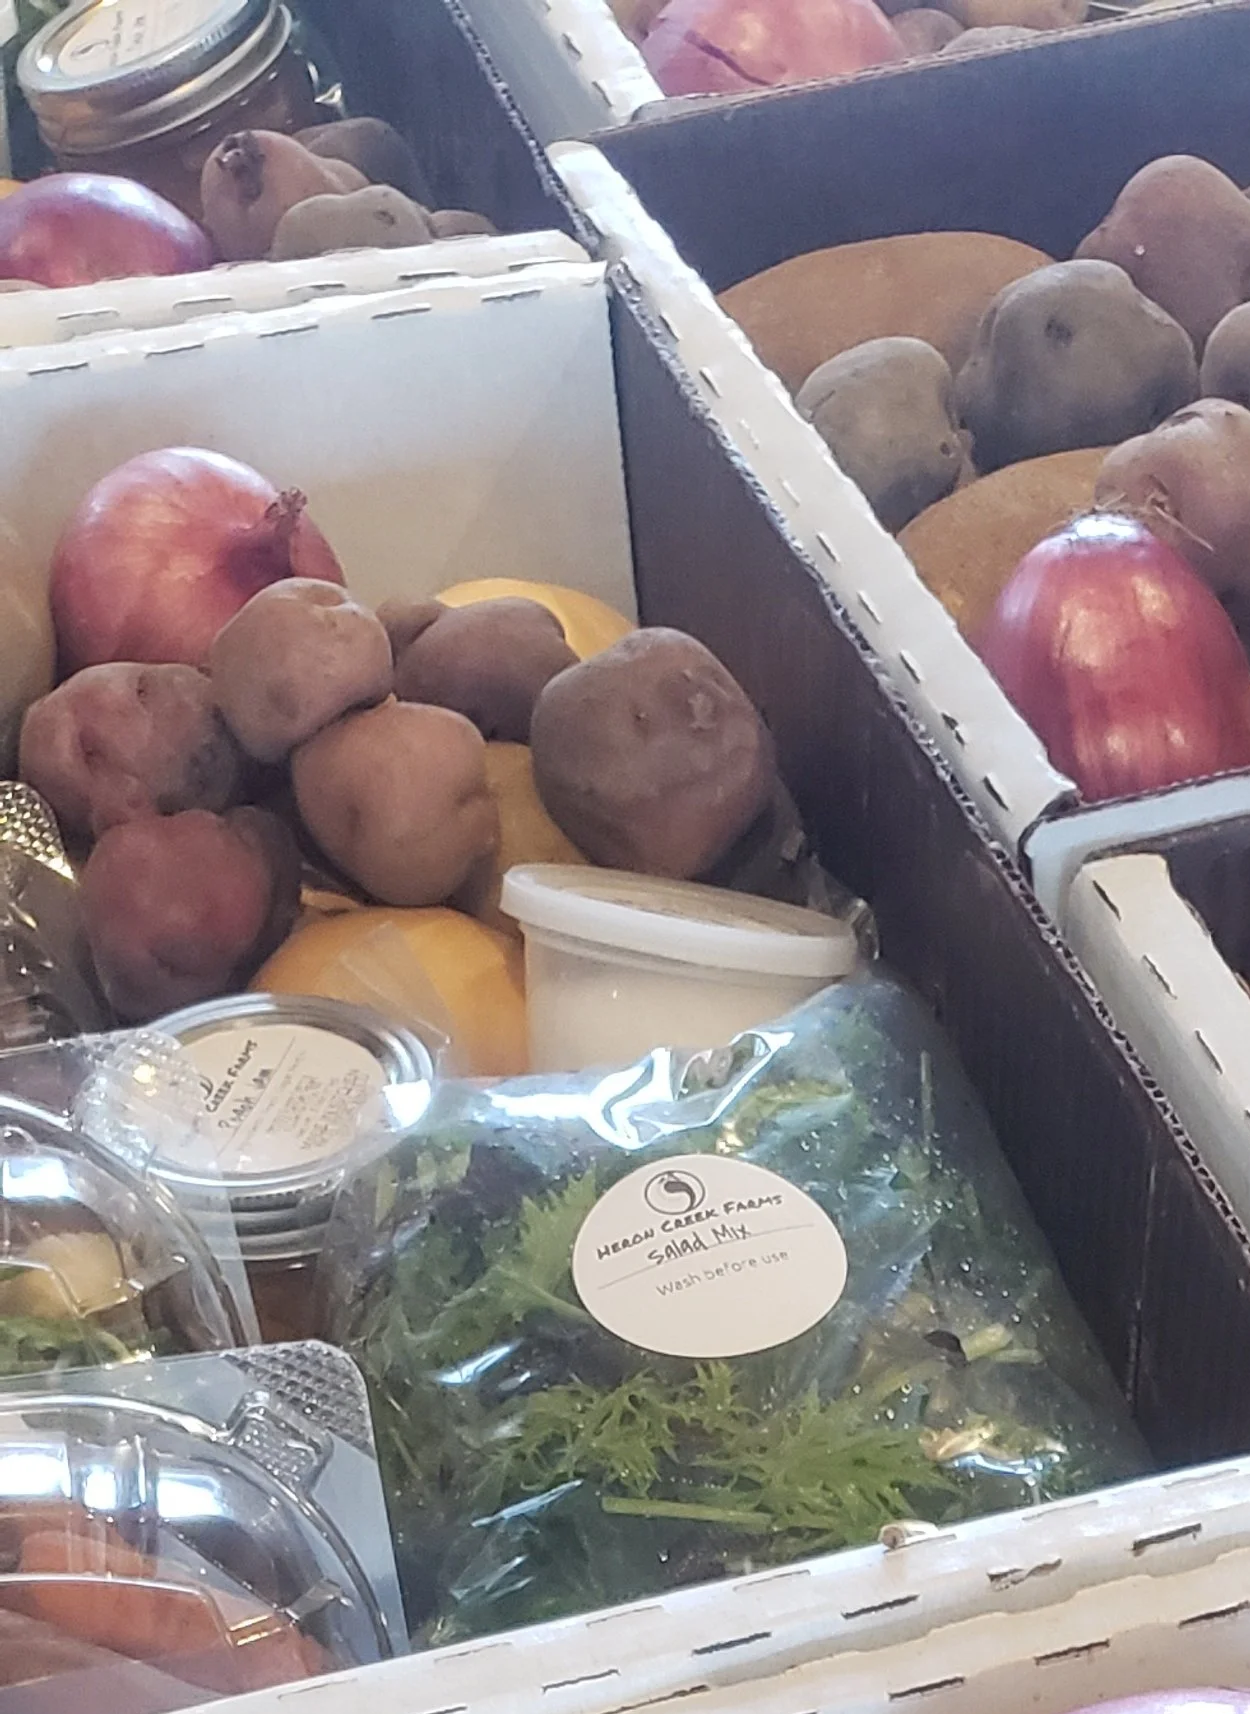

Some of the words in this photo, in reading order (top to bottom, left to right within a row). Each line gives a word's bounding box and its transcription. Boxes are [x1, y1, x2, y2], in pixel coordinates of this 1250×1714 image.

[596, 1227, 655, 1260] HERON
[660, 1207, 719, 1234] CREEK
[723, 1194, 783, 1215] FARMS
[712, 1222, 751, 1246] Mix
[656, 1273, 701, 1297] Wash
[704, 1256, 758, 1281] before
[763, 1250, 790, 1265] use
